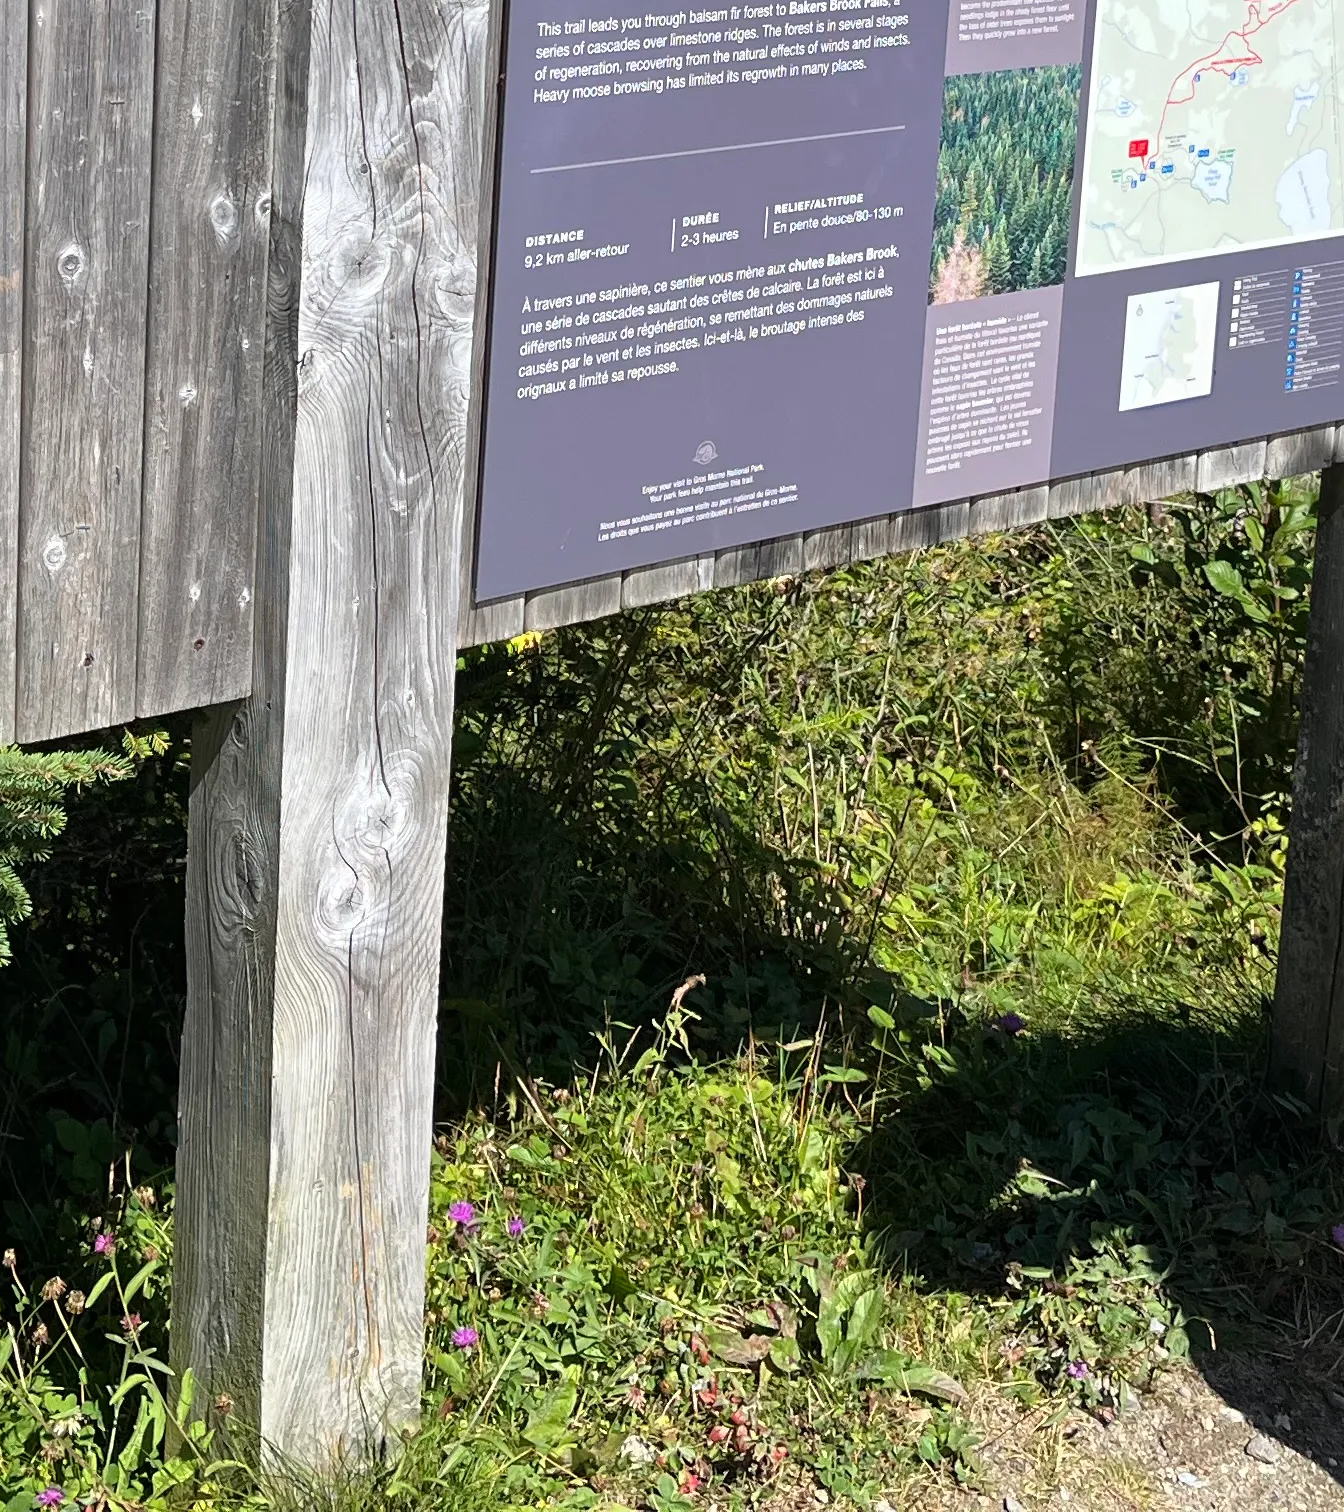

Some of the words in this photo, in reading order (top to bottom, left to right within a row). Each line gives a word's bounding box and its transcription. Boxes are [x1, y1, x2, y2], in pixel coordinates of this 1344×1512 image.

[536, 44, 570, 59] series
[572, 40, 585, 56] of
[587, 37, 640, 54] cascades
[643, 36, 668, 49] over
[670, 31, 722, 46] limestone
[724, 27, 759, 44] ridges.
[762, 24, 782, 38] The
[784, 21, 814, 36] forest
[816, 20, 825, 33] is
[827, 19, 836, 32] in
[838, 15, 874, 31] several
[876, 15, 909, 29] stages
[537, 22, 561, 37] This
[564, 19, 585, 34] trail
[588, 16, 619, 32] leads
[621, 18, 642, 33] you
[644, 11, 686, 28] through
[689, 9, 728, 24] balsam
[730, 6, 742, 20] fir
[743, 4, 774, 19] forest
[776, 3, 787, 16] to
[789, 0, 827, 15] Bakers
[534, 65, 547, 81] of
[549, 60, 622, 82] regeneration,
[626, 55, 683, 72] recovering
[686, 52, 710, 66] from
[713, 49, 730, 64] the
[732, 45, 768, 61] natural
[770, 43, 805, 58] effects
[807, 40, 819, 54] of
[820, 38, 850, 53] winds
[852, 35, 871, 50] and
[873, 33, 911, 48] insects.
[534, 88, 570, 103] Heavy
[572, 85, 611, 99] moose
[613, 78, 663, 95] browsing
[666, 76, 686, 89] has
[688, 70, 724, 87] limited
[726, 70, 739, 83] its
[741, 64, 787, 84] regrowth
[789, 64, 799, 77] in
[801, 63, 829, 77] many
[831, 58, 867, 75] places.
[682, 211, 719, 227] DURÉE
[773, 221, 787, 234] En
[789, 218, 819, 234] pente
[821, 206, 891, 227] douce/80-130
[893, 207, 903, 217] m
[774, 193, 864, 215] RELIEF/ALTITUDE
[524, 253, 543, 269] 9,2
[546, 252, 564, 265] km
[567, 244, 630, 262] aller-retour
[526, 229, 584, 248] DISTANCE
[681, 232, 700, 247] 2-3
[702, 230, 739, 244] heures
[522, 296, 531, 314] À
[534, 295, 573, 311] travers
[575, 292, 597, 305] une
[599, 282, 651, 303] sapinière,
[654, 281, 668, 293] ce
[670, 275, 707, 291] sentier
[708, 271, 733, 285] vous
[736, 265, 765, 280] mène
[767, 263, 786, 276] aux
[788, 257, 825, 273] chutes
[827, 251, 864, 267] Bakers
[866, 244, 899, 261] Brook,
[521, 321, 543, 335] une
[545, 314, 573, 331] série
[575, 311, 590, 326] de
[592, 304, 645, 323] cascades
[647, 296, 687, 315] sautant
[689, 294, 709, 308] des
[711, 289, 744, 304] crêtes
[746, 285, 760, 299] de
[762, 280, 804, 297] calcaire.
[807, 276, 820, 290] La
[822, 272, 845, 287] forêt
[847, 269, 863, 284] est
[864, 267, 876, 280] ici
[878, 265, 885, 279] à
[520, 336, 572, 356] différents
[575, 330, 617, 347] niveaux
[620, 325, 634, 340] de
[637, 316, 706, 338] régénération,
[709, 313, 722, 325] se
[724, 303, 774, 323] remettant
[776, 301, 795, 315] des
[797, 293, 852, 311] dommages
[854, 284, 893, 301] naturels
[518, 358, 559, 377] causés
[561, 357, 581, 373] par
[583, 353, 593, 367] le
[596, 348, 619, 364] vent
[622, 346, 633, 360] et
[635, 344, 651, 358] les
[654, 337, 700, 354] insectes.
[704, 327, 746, 346] Ici-et-là,
[749, 325, 759, 339] le
[761, 320, 806, 337] broutage
[808, 313, 844, 328] intense
[846, 309, 865, 323] des
[517, 380, 566, 400] orignaux
[569, 378, 577, 390] a
[579, 370, 609, 388] limité
[611, 370, 624, 382] sa
[627, 361, 679, 381] repousse.
